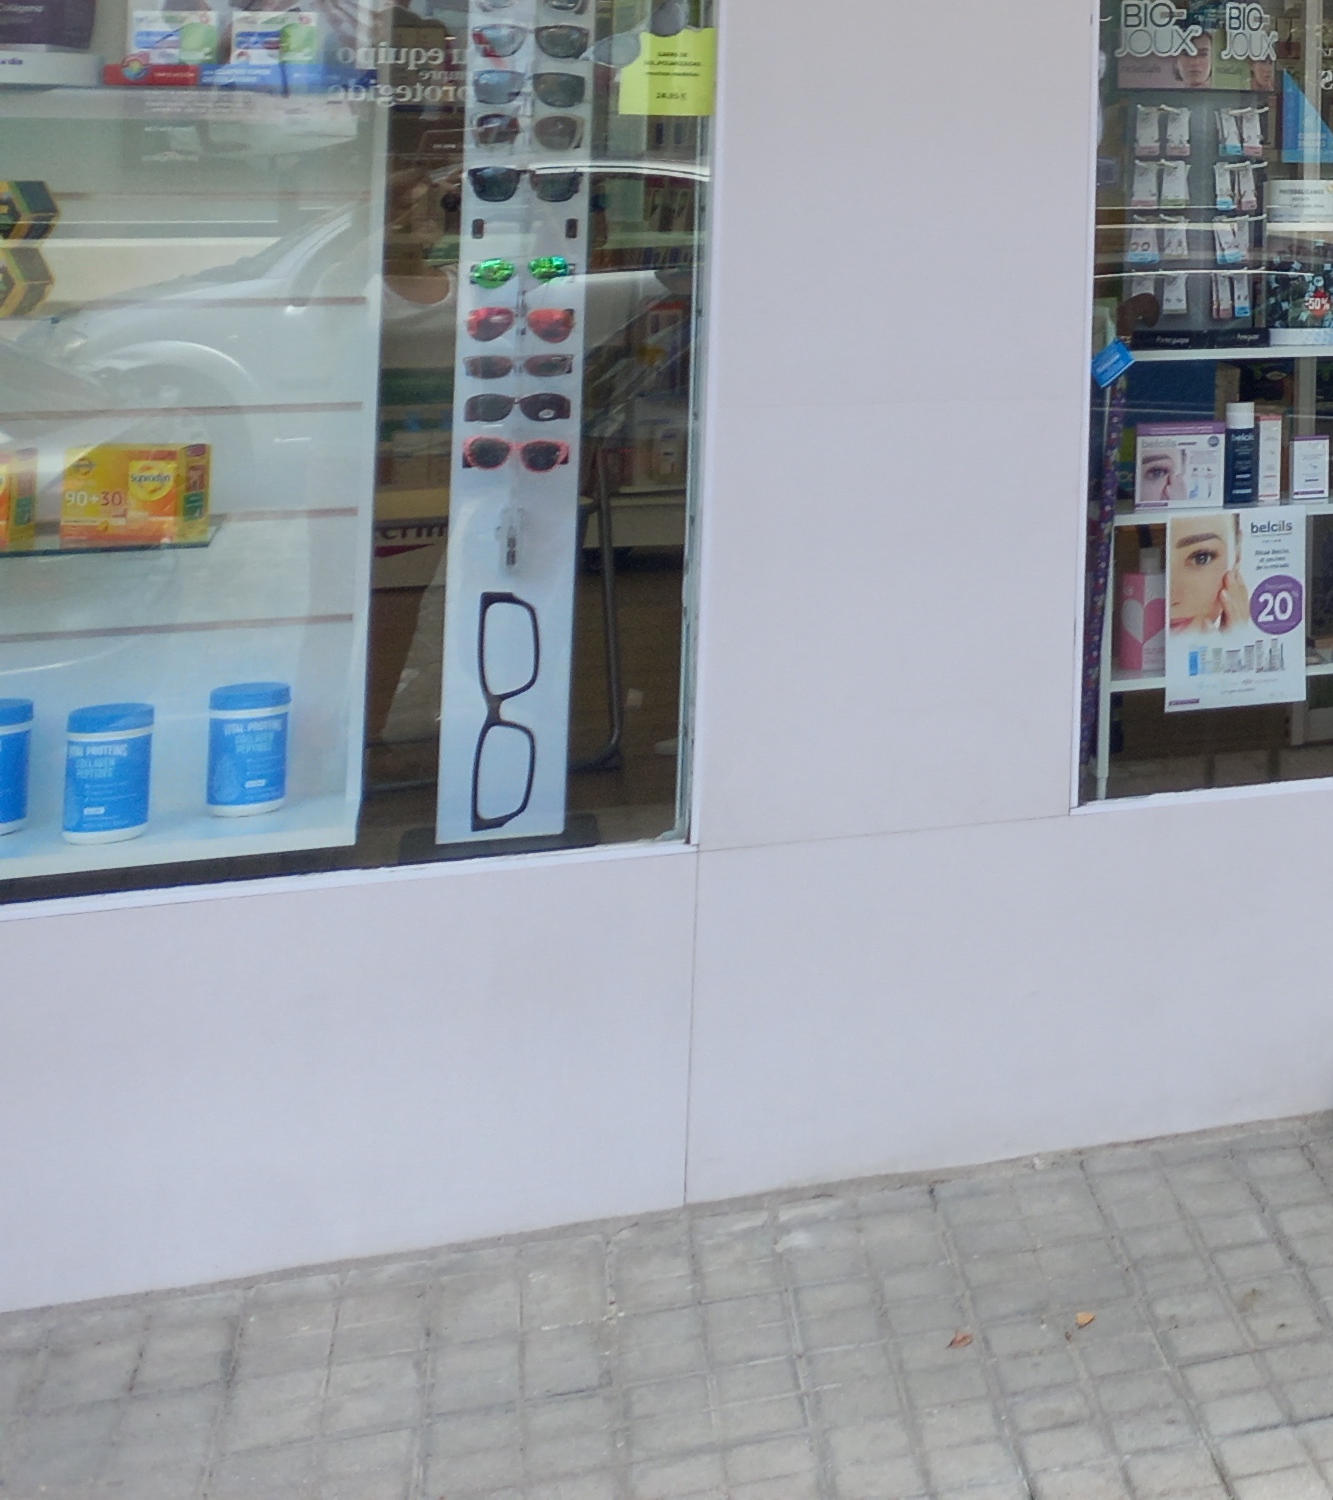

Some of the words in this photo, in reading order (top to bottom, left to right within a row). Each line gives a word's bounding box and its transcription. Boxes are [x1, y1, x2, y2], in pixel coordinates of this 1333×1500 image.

[1124, 2, 1185, 28] BIO-
[1229, 6, 1270, 31] BIO-
[1305, 296, 1330, 311] -50%
[1250, 520, 1293, 534] belcils
[86, 743, 129, 757] PROTEINS
